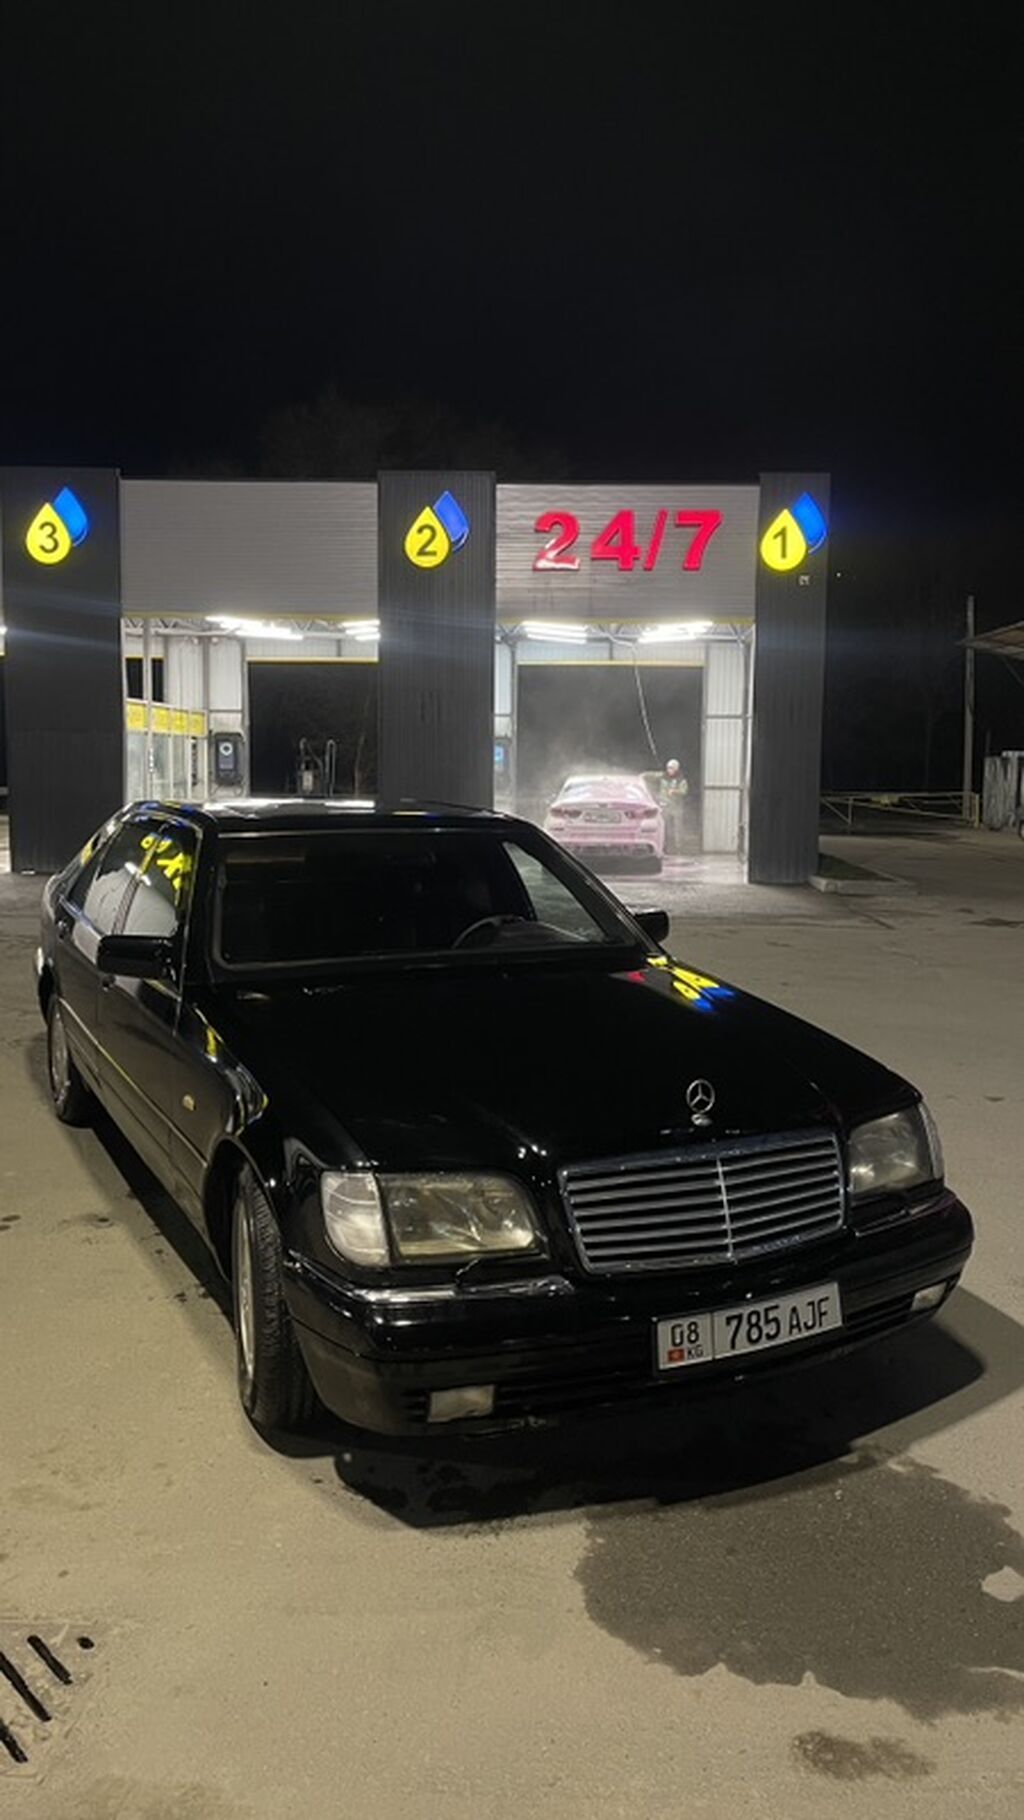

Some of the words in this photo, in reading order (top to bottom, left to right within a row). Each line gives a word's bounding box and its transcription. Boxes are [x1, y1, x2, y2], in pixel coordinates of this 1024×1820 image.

[39, 521, 59, 554] 3
[416, 524, 438, 557] 2
[533, 509, 722, 571] 24/7
[773, 526, 788, 560] 1
[671, 1321, 700, 1348] 08
[725, 1305, 782, 1350] 785
[788, 1296, 830, 1336] AJF
